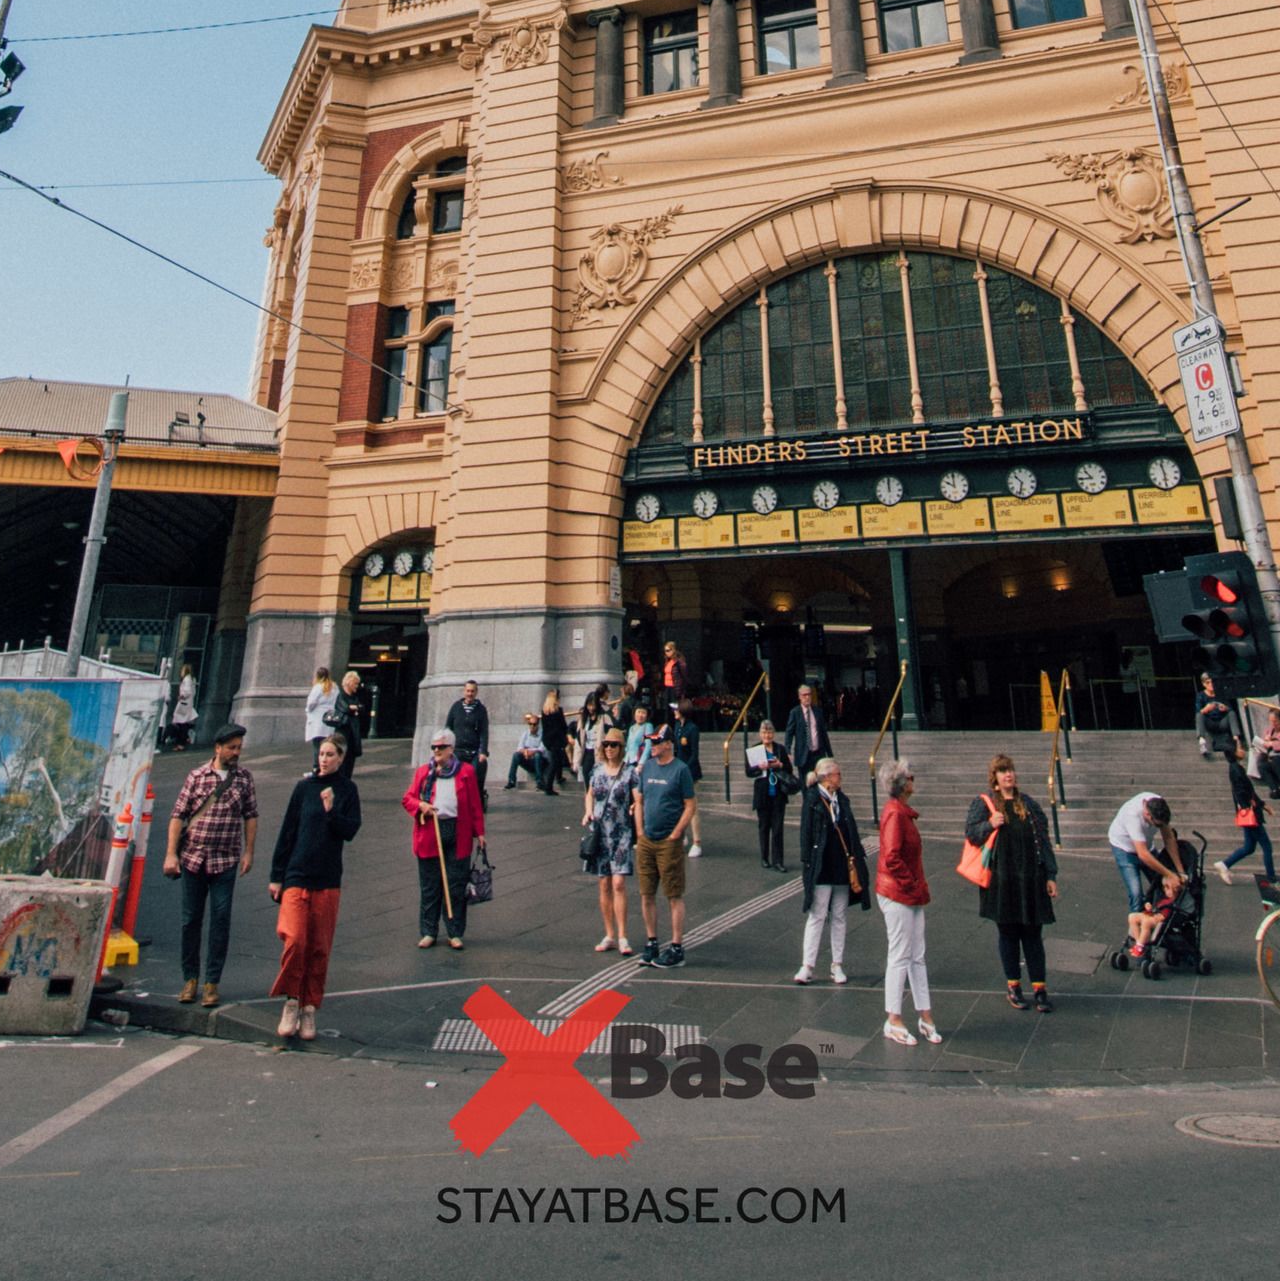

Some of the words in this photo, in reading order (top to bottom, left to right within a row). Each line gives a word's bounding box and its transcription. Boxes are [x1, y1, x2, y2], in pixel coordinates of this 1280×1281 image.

[1181, 347, 1218, 369] CLEARWAY
[693, 440, 807, 468] FLINDERS
[838, 429, 931, 457] STREET
[963, 417, 1083, 448] STATION
[1065, 494, 1094, 504] UPFIELD
